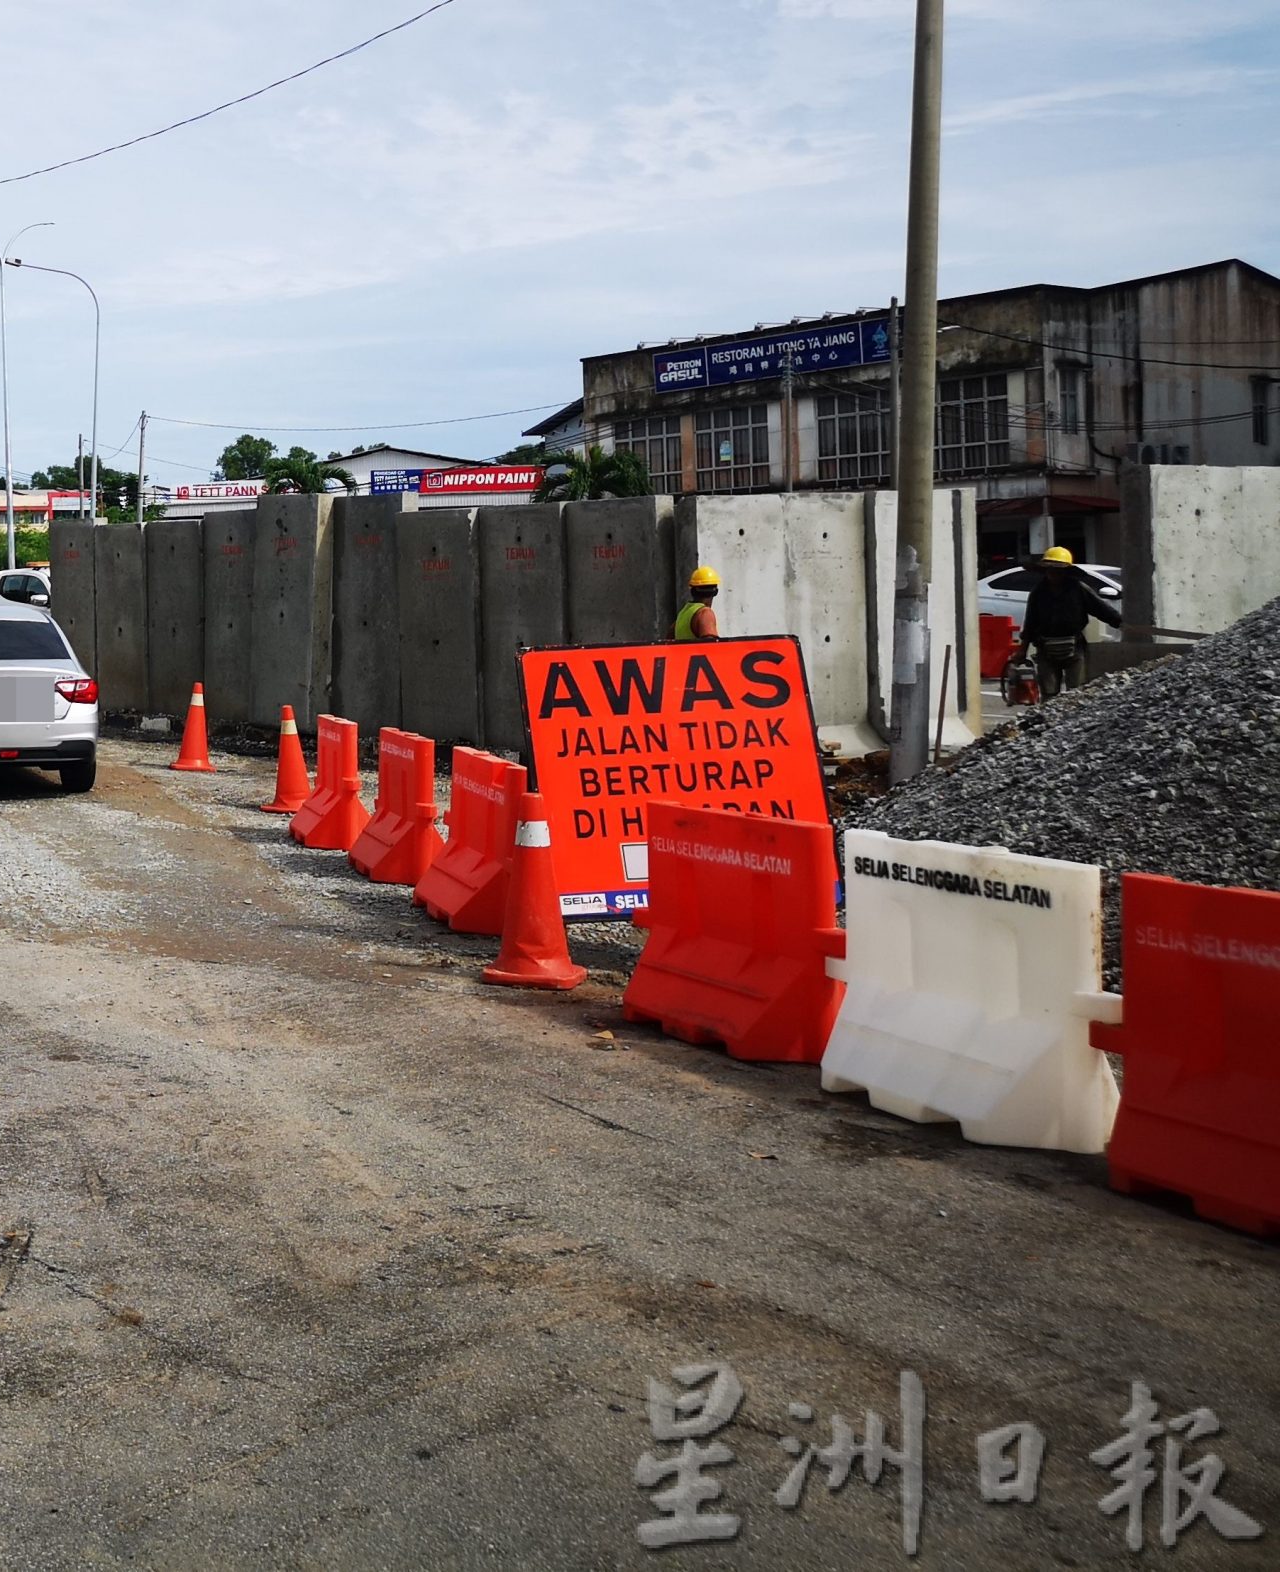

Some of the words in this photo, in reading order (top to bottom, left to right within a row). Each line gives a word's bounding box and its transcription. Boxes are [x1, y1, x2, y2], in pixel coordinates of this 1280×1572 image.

[711, 345, 764, 364] RESTORAN
[766, 344, 775, 356] JI
[776, 339, 806, 355] TONG
[807, 336, 821, 349] YA
[822, 331, 855, 348] JIANG
[660, 367, 703, 383] GASUL
[667, 358, 702, 371] PETRON
[192, 487, 223, 497] TETT
[225, 485, 257, 497] PANN
[443, 473, 495, 485] NIPPON
[497, 472, 537, 484] PAINT
[538, 650, 792, 720] AWAS
[557, 723, 669, 757] JALAN
[679, 717, 790, 750] TIDAK
[579, 759, 775, 797] BERTURAP
[574, 808, 607, 838] DI
[652, 836, 676, 854] SELIA
[743, 851, 791, 875] SELATAN
[854, 856, 890, 880] SELIA
[891, 862, 983, 897] SELENGGARA
[983, 879, 1052, 909] SELATAN
[1135, 925, 1187, 952] SELIA
